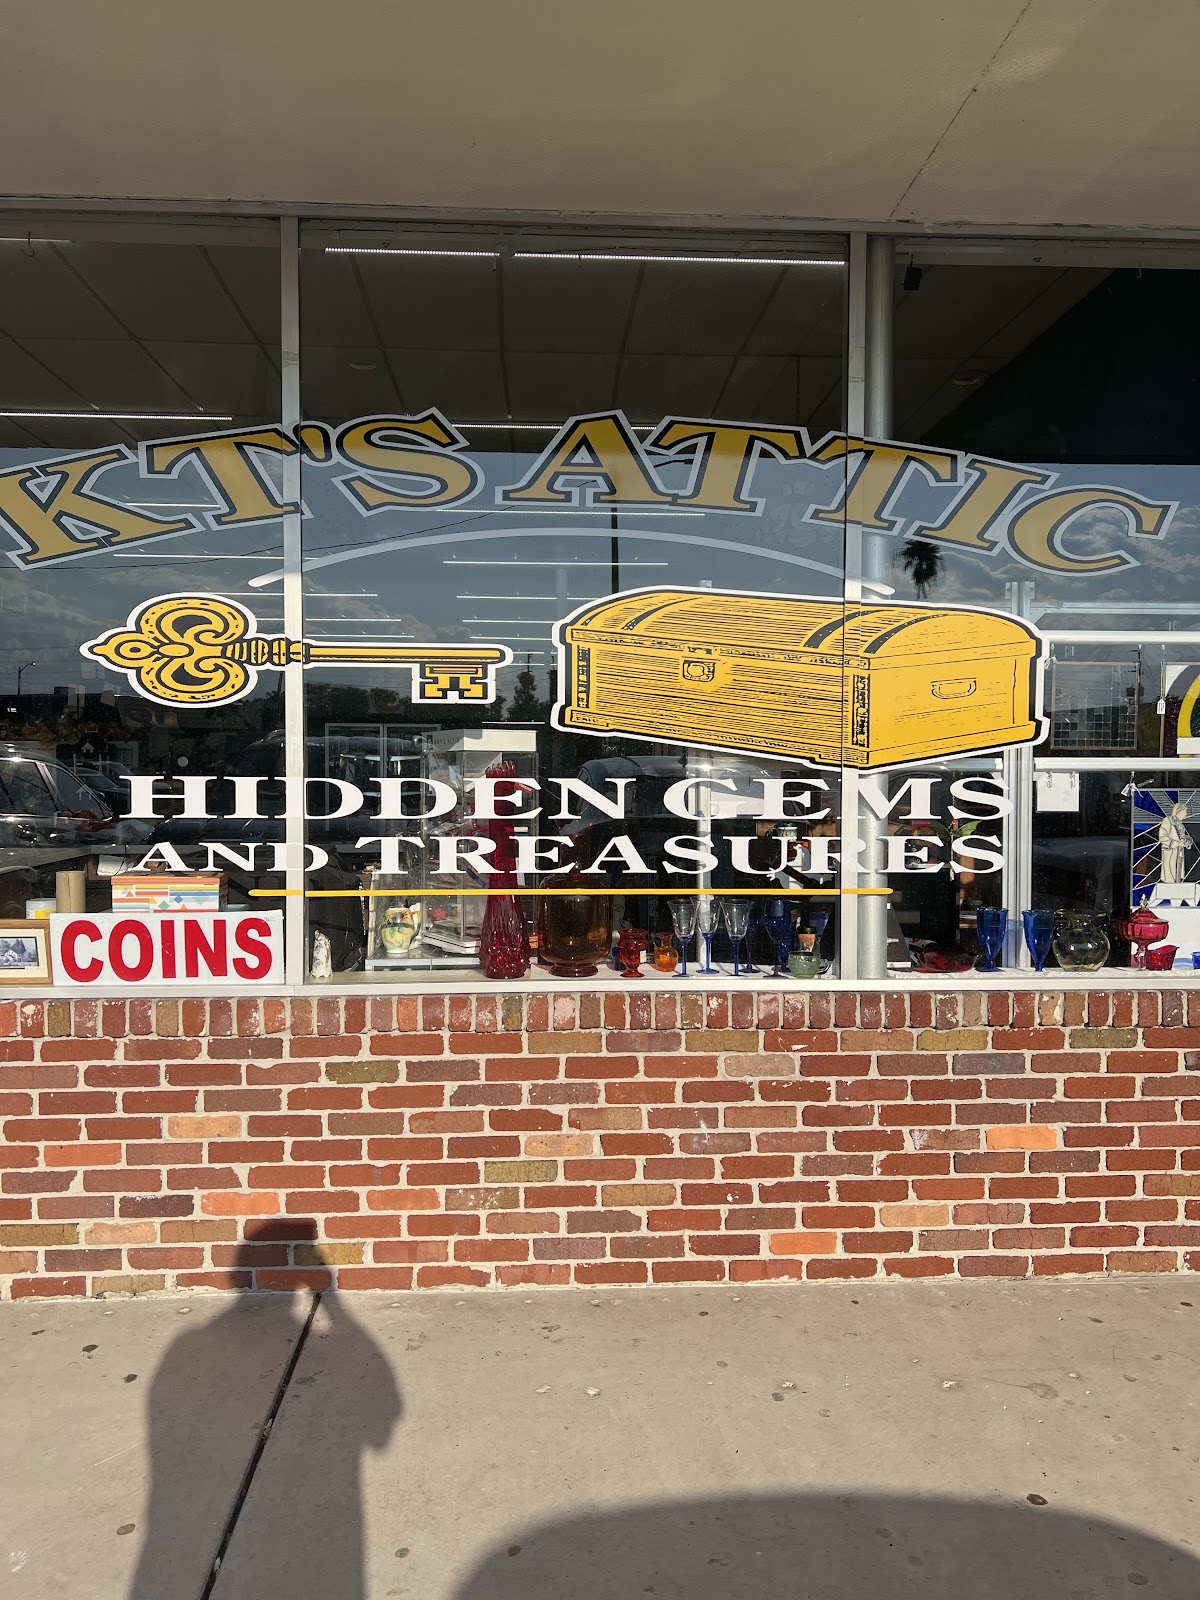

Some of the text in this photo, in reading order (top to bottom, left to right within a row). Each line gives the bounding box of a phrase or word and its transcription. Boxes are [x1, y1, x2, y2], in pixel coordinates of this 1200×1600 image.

[0, 406, 1179, 576] KT'S ATTIC
[119, 776, 1014, 821] HIDDEN GEMS
[129, 835, 1004, 875] AND TREASURES
[60, 917, 273, 983] COINS
